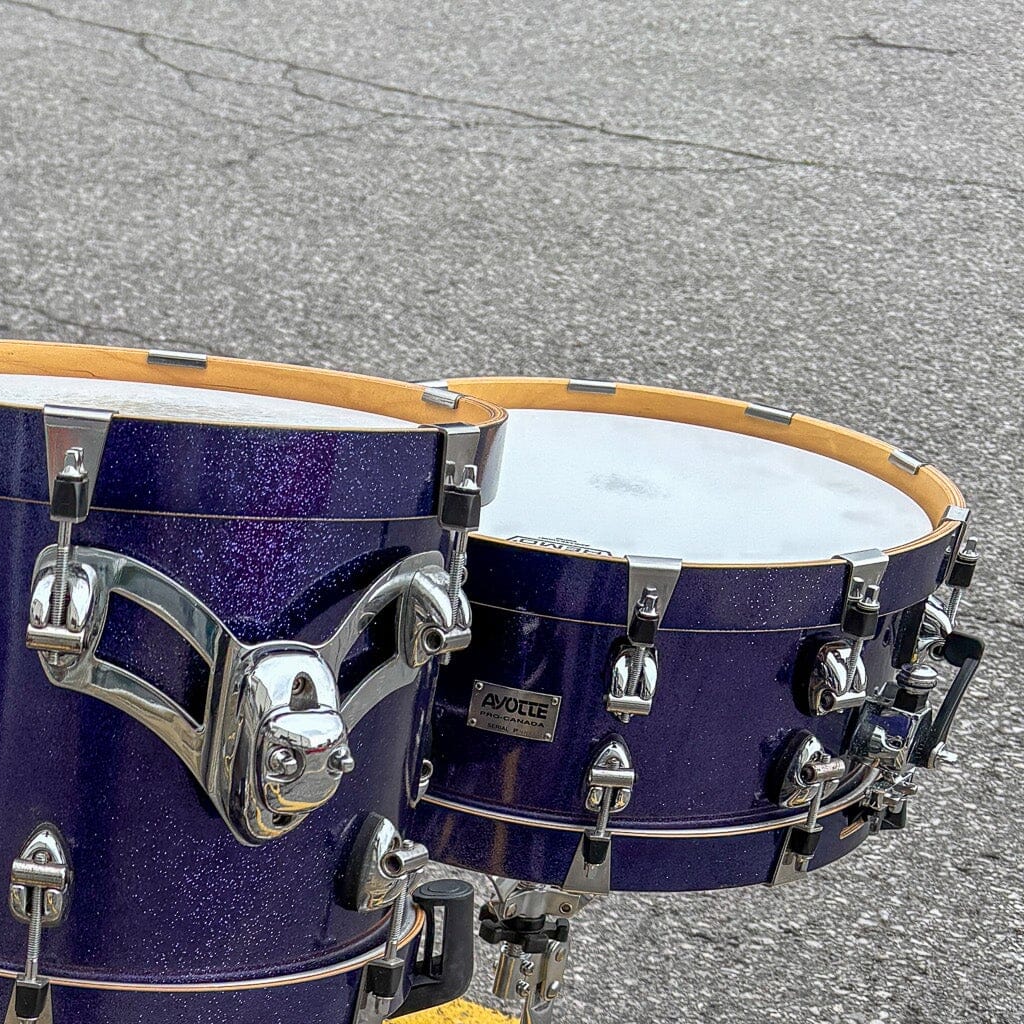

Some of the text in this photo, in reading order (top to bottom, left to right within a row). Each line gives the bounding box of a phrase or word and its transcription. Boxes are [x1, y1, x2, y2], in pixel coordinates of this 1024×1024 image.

[481, 693, 549, 720] AYOTTE
[480, 710, 545, 728] PRO-CANADA
[487, 722, 509, 733] SERIAL
